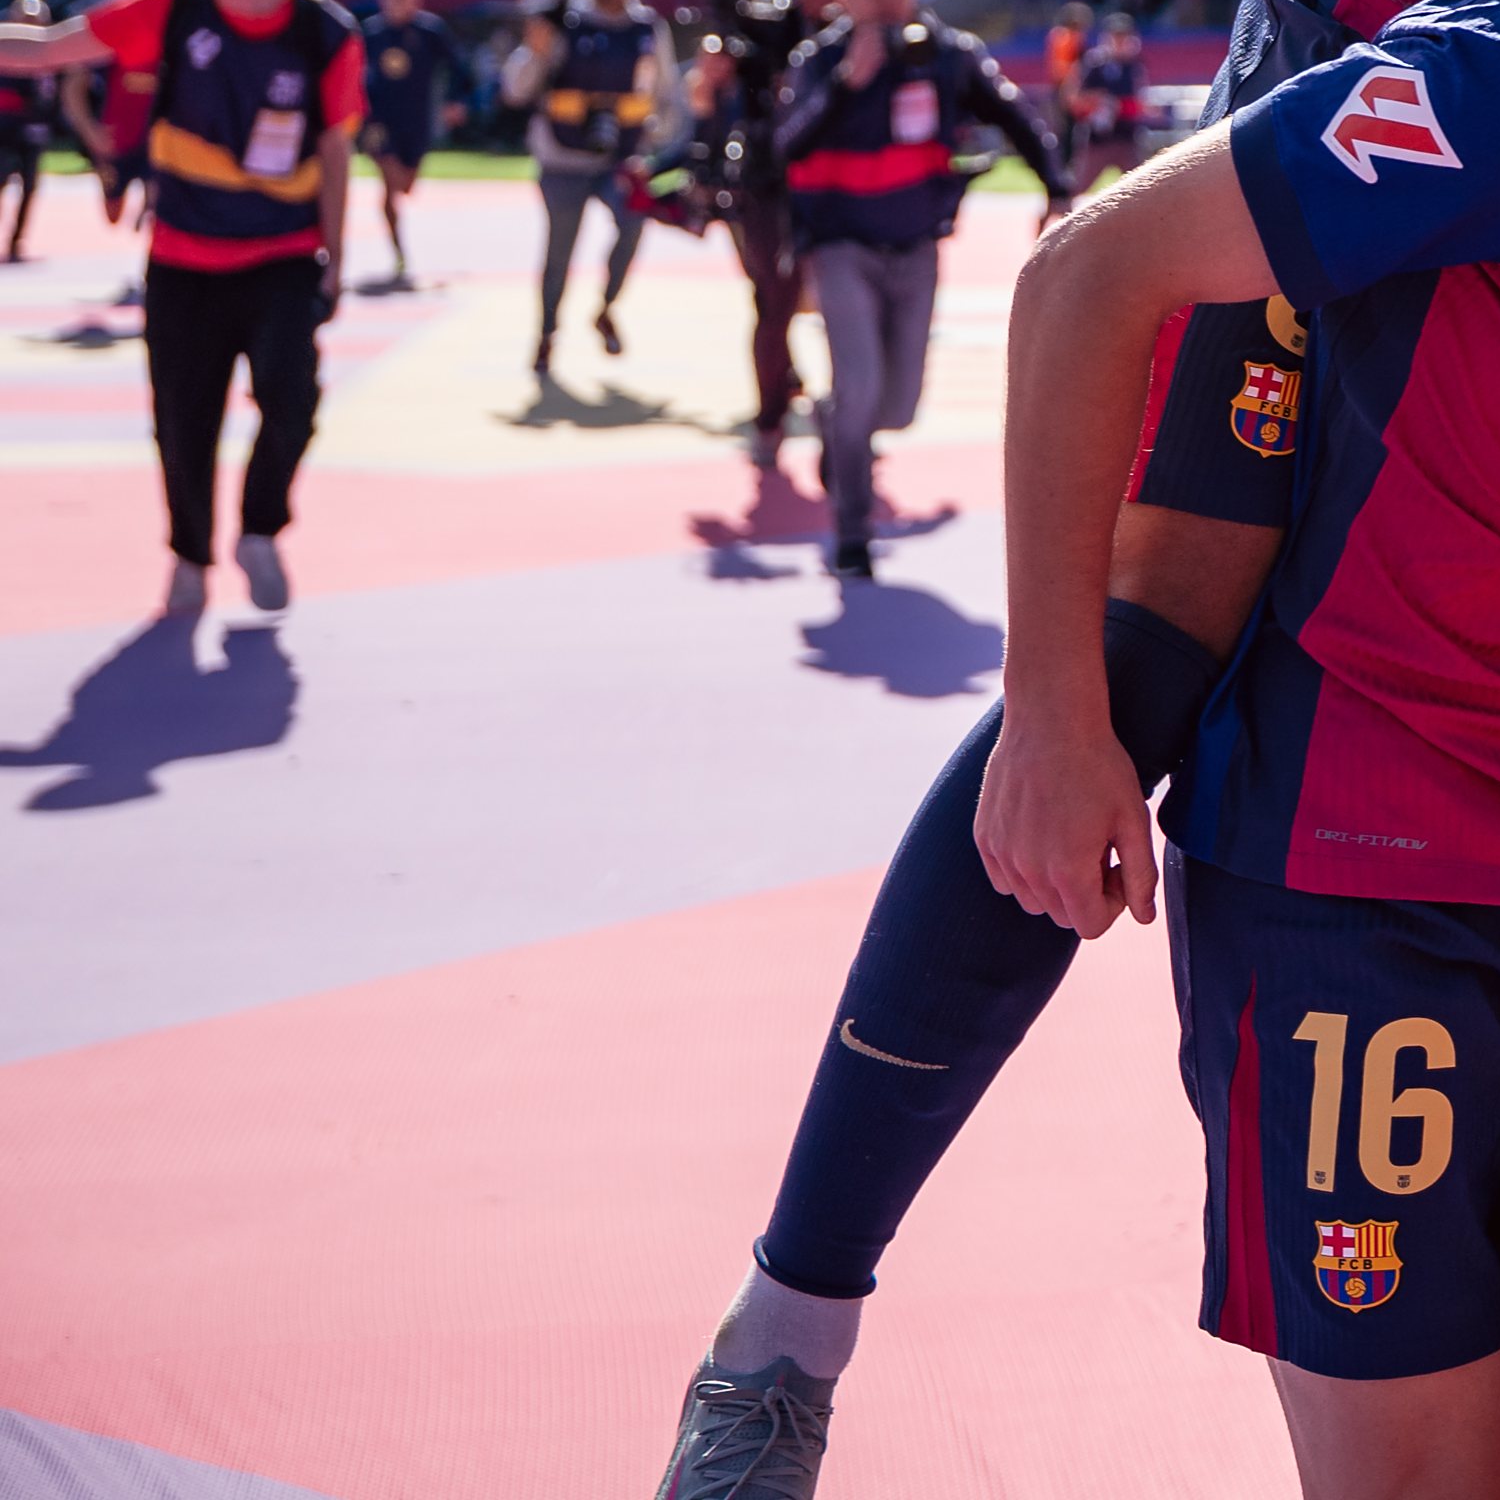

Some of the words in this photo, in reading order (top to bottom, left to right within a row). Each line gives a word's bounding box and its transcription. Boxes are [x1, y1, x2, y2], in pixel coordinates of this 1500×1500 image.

[1259, 401, 1292, 417] FCB
[1292, 1011, 1456, 1195] 16
[1337, 1258, 1374, 1270] FCB
